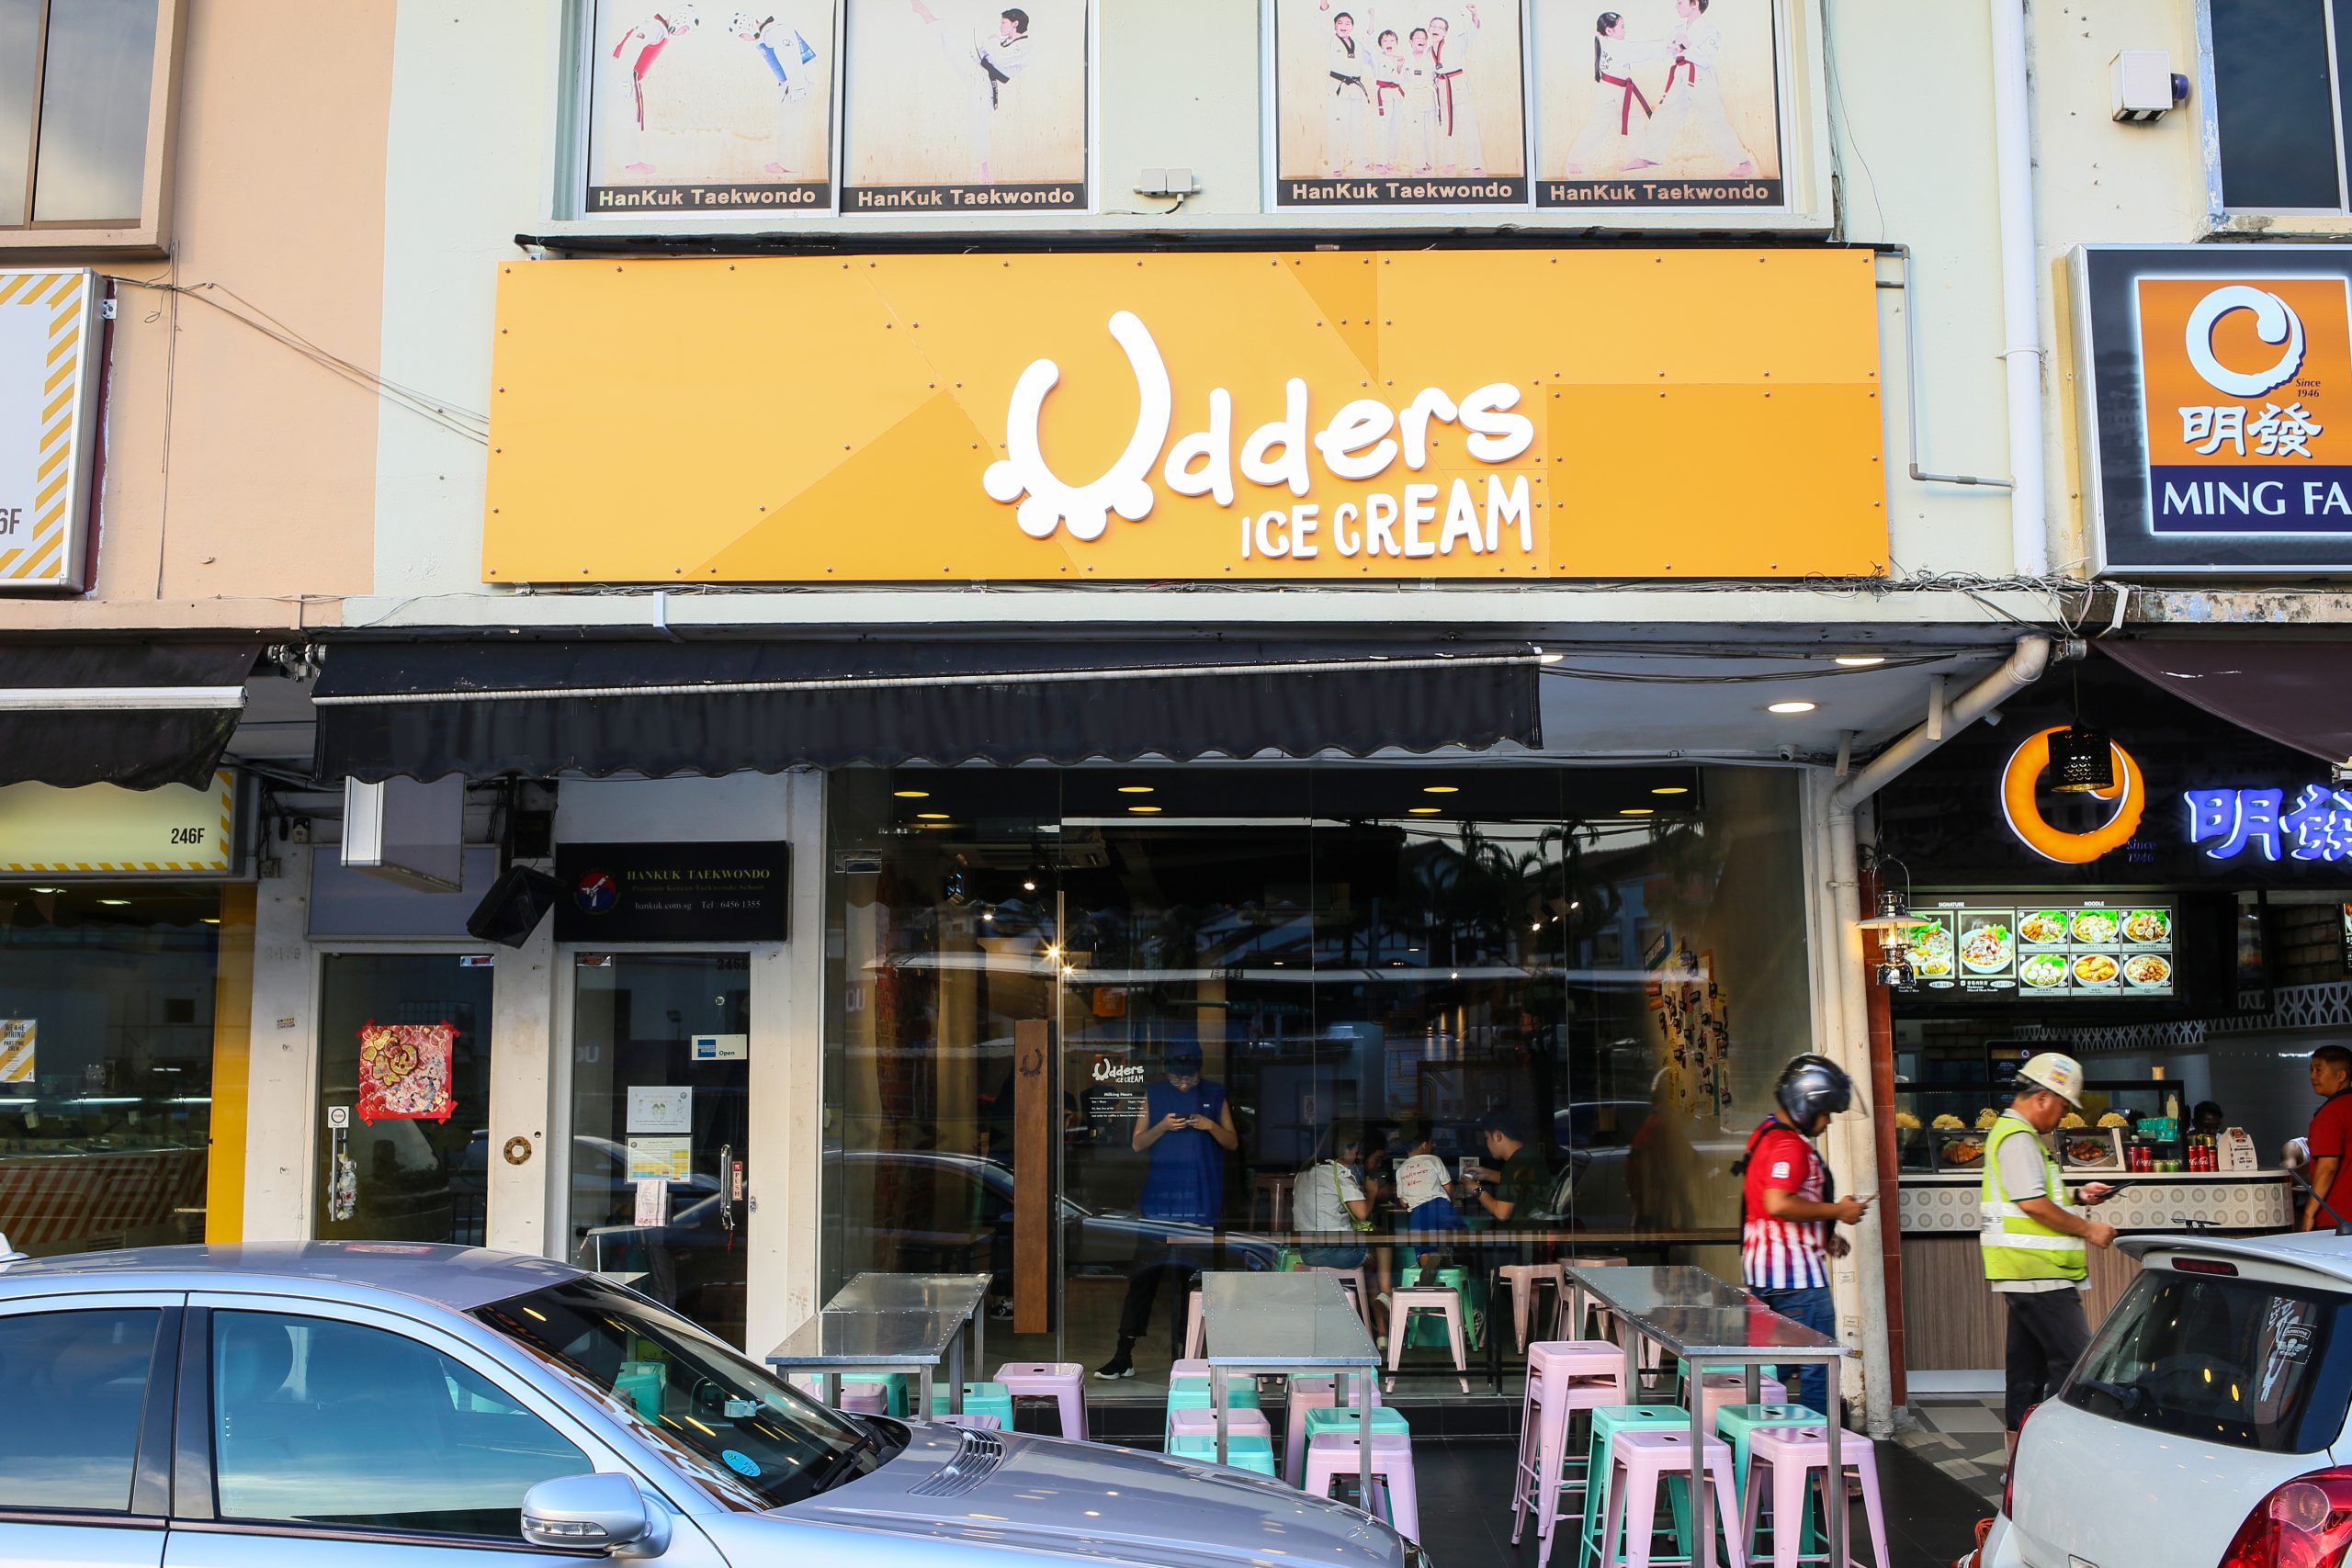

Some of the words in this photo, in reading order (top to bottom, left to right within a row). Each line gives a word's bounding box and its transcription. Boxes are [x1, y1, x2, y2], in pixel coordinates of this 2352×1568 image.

[598, 189, 684, 207] HanKuk
[691, 187, 816, 205] Taekwondo
[857, 189, 943, 208] HanKuk
[949, 187, 1075, 206] Taekwondo
[1292, 182, 1378, 201] HanKuk
[1385, 181, 1513, 200] Taekwondo
[1550, 184, 1635, 202] HanKuk
[1643, 183, 1769, 201] Taekwondo
[2295, 378, 2321, 388] Since
[2297, 389, 2319, 398] 1946
[982, 310, 1535, 540] Udders
[2177, 401, 2324, 458] 明發
[2163, 480, 2286, 515] MING
[2302, 481, 2352, 515] FA
[1241, 503, 1319, 559] ICE
[1333, 473, 1532, 559] CREAM
[171, 828, 205, 844] 246F
[628, 871, 681, 881] HANKUK
[689, 869, 770, 880] TAEKWONDO
[1091, 1058, 1145, 1081] Udders
